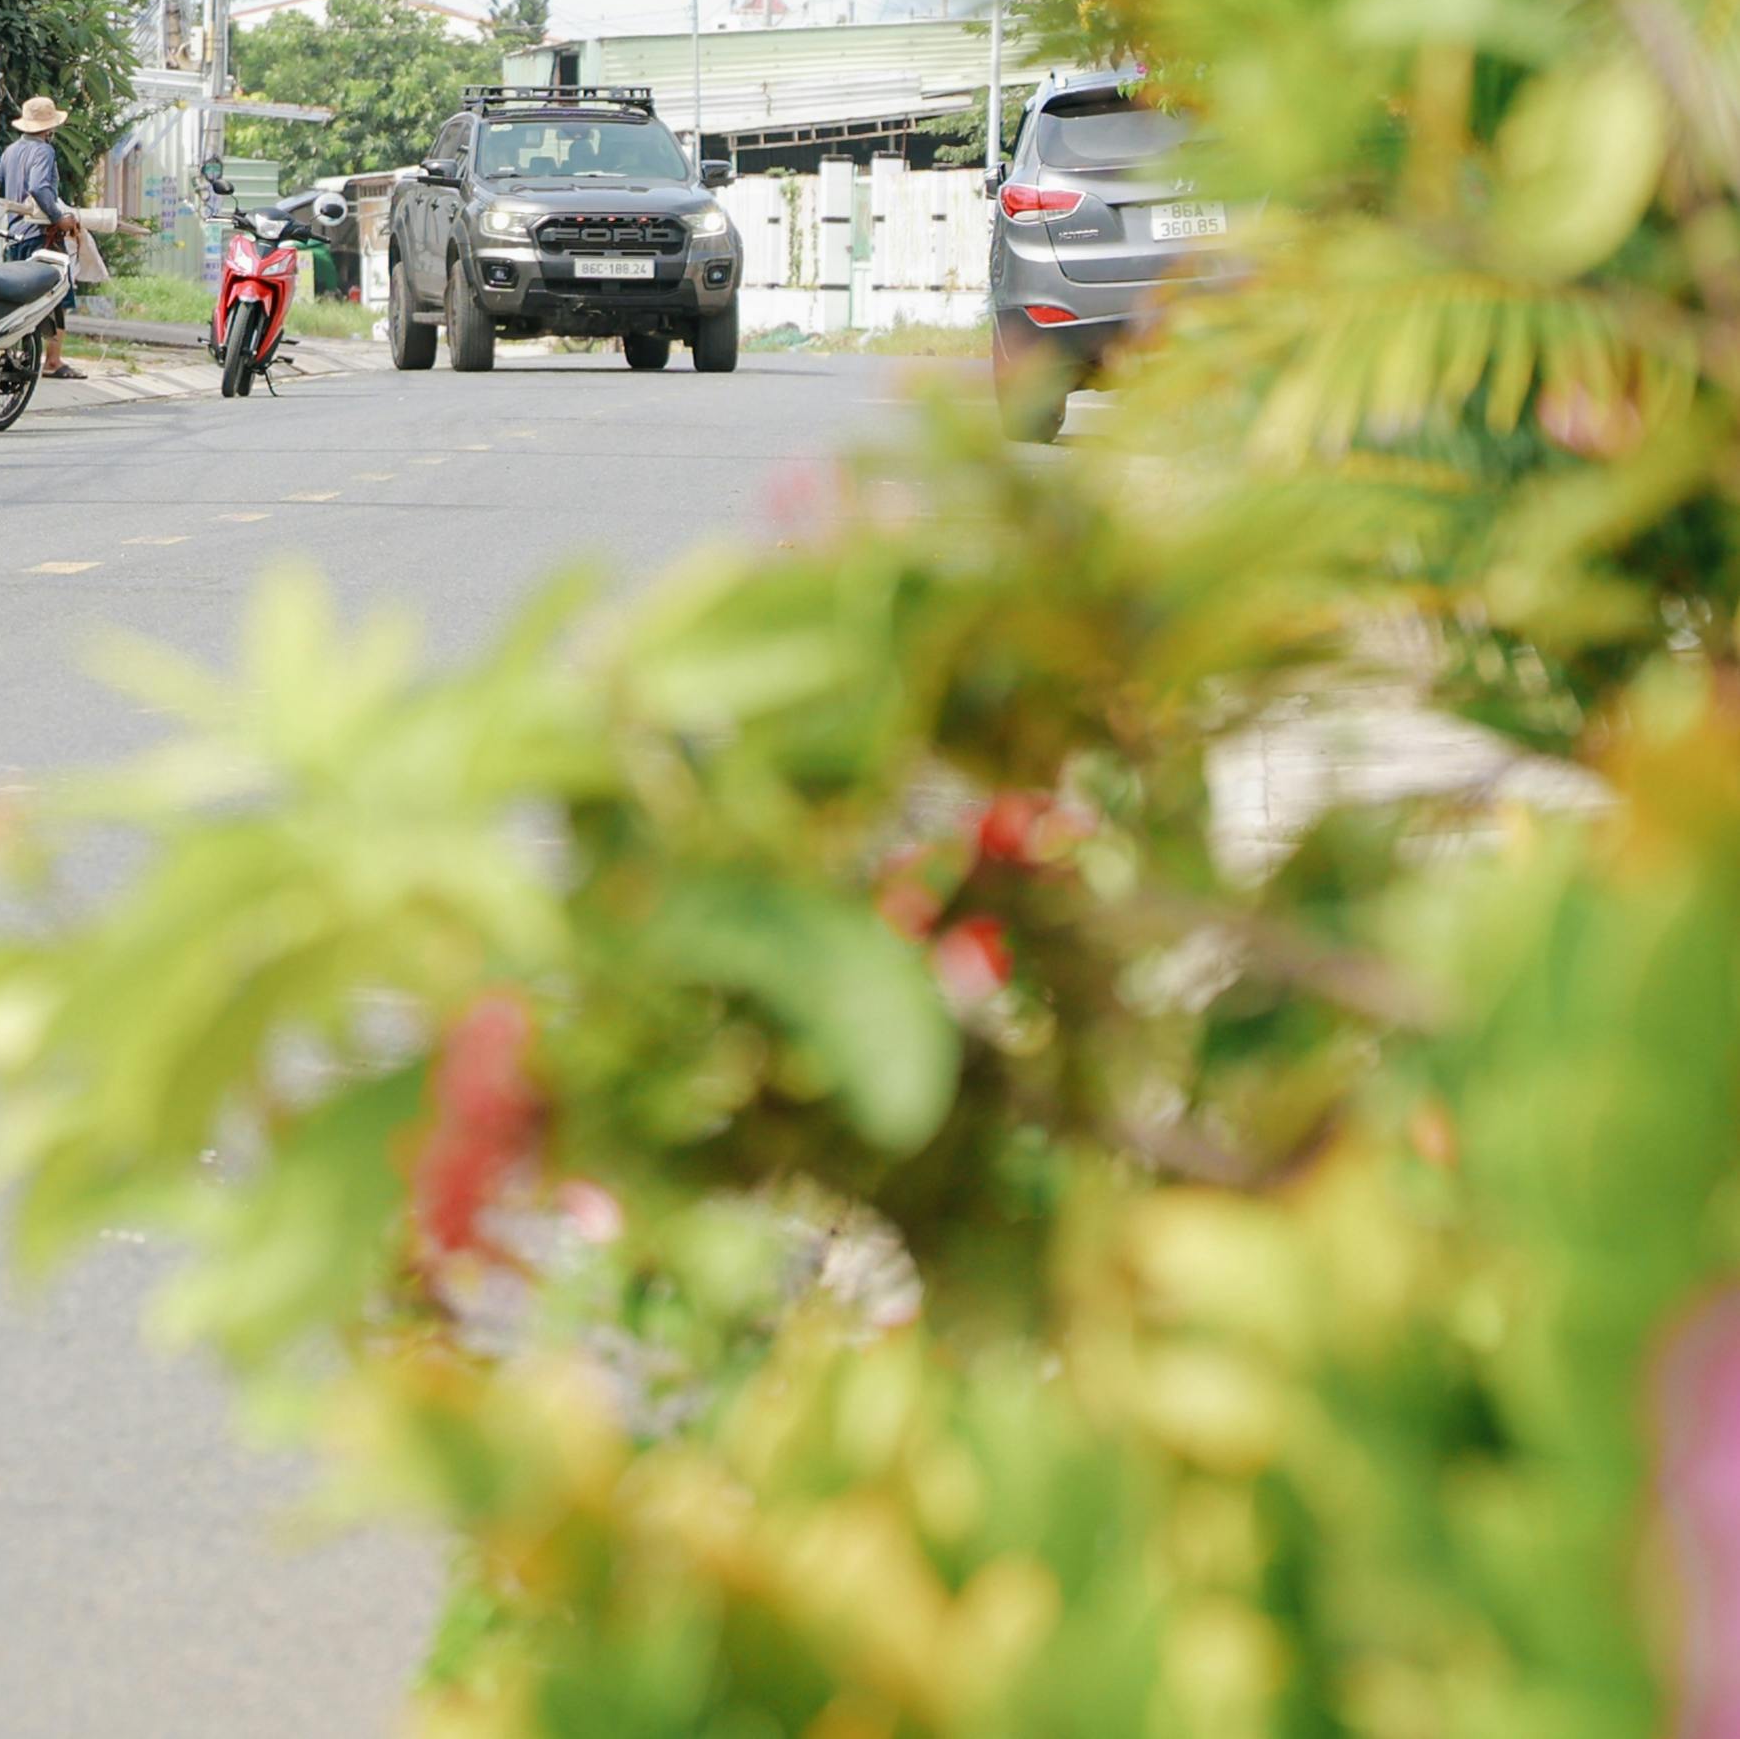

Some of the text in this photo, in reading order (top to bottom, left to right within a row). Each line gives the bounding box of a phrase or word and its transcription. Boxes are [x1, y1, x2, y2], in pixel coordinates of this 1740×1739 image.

[1171, 203, 1204, 220] 86A
[545, 227, 674, 243] FORD
[1160, 218, 1219, 238] 360.85
